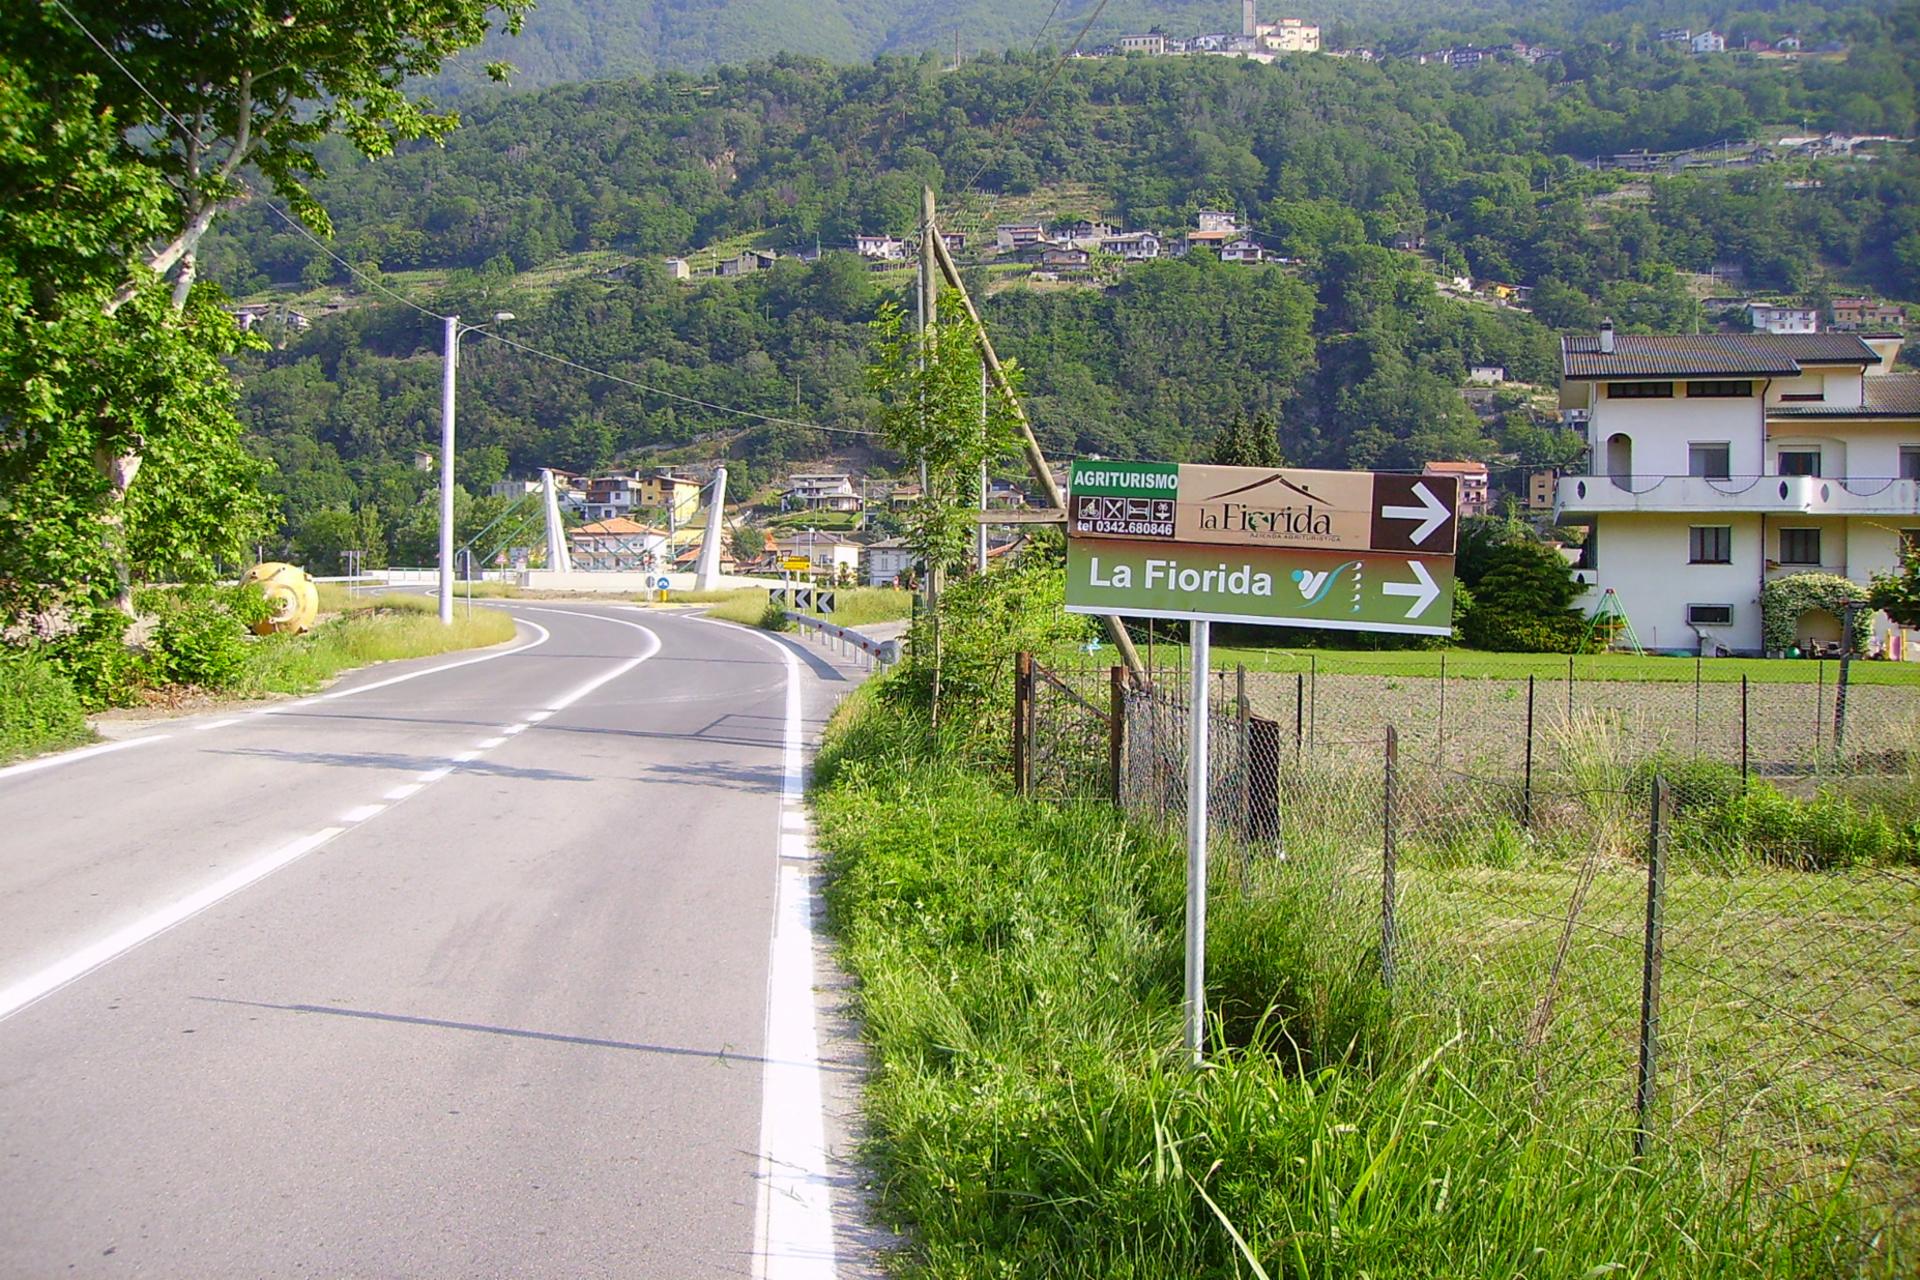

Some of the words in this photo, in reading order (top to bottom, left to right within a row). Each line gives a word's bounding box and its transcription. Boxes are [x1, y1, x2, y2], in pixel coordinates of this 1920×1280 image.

[1074, 470, 1178, 490] AGRITURISMO
[1077, 520, 1093, 532] tel
[1096, 520, 1173, 536] 0342.680846
[1200, 508, 1217, 529] la
[1223, 503, 1331, 534] Fiorida
[1089, 557, 1132, 588] La
[1145, 559, 1272, 596] Fiorida
